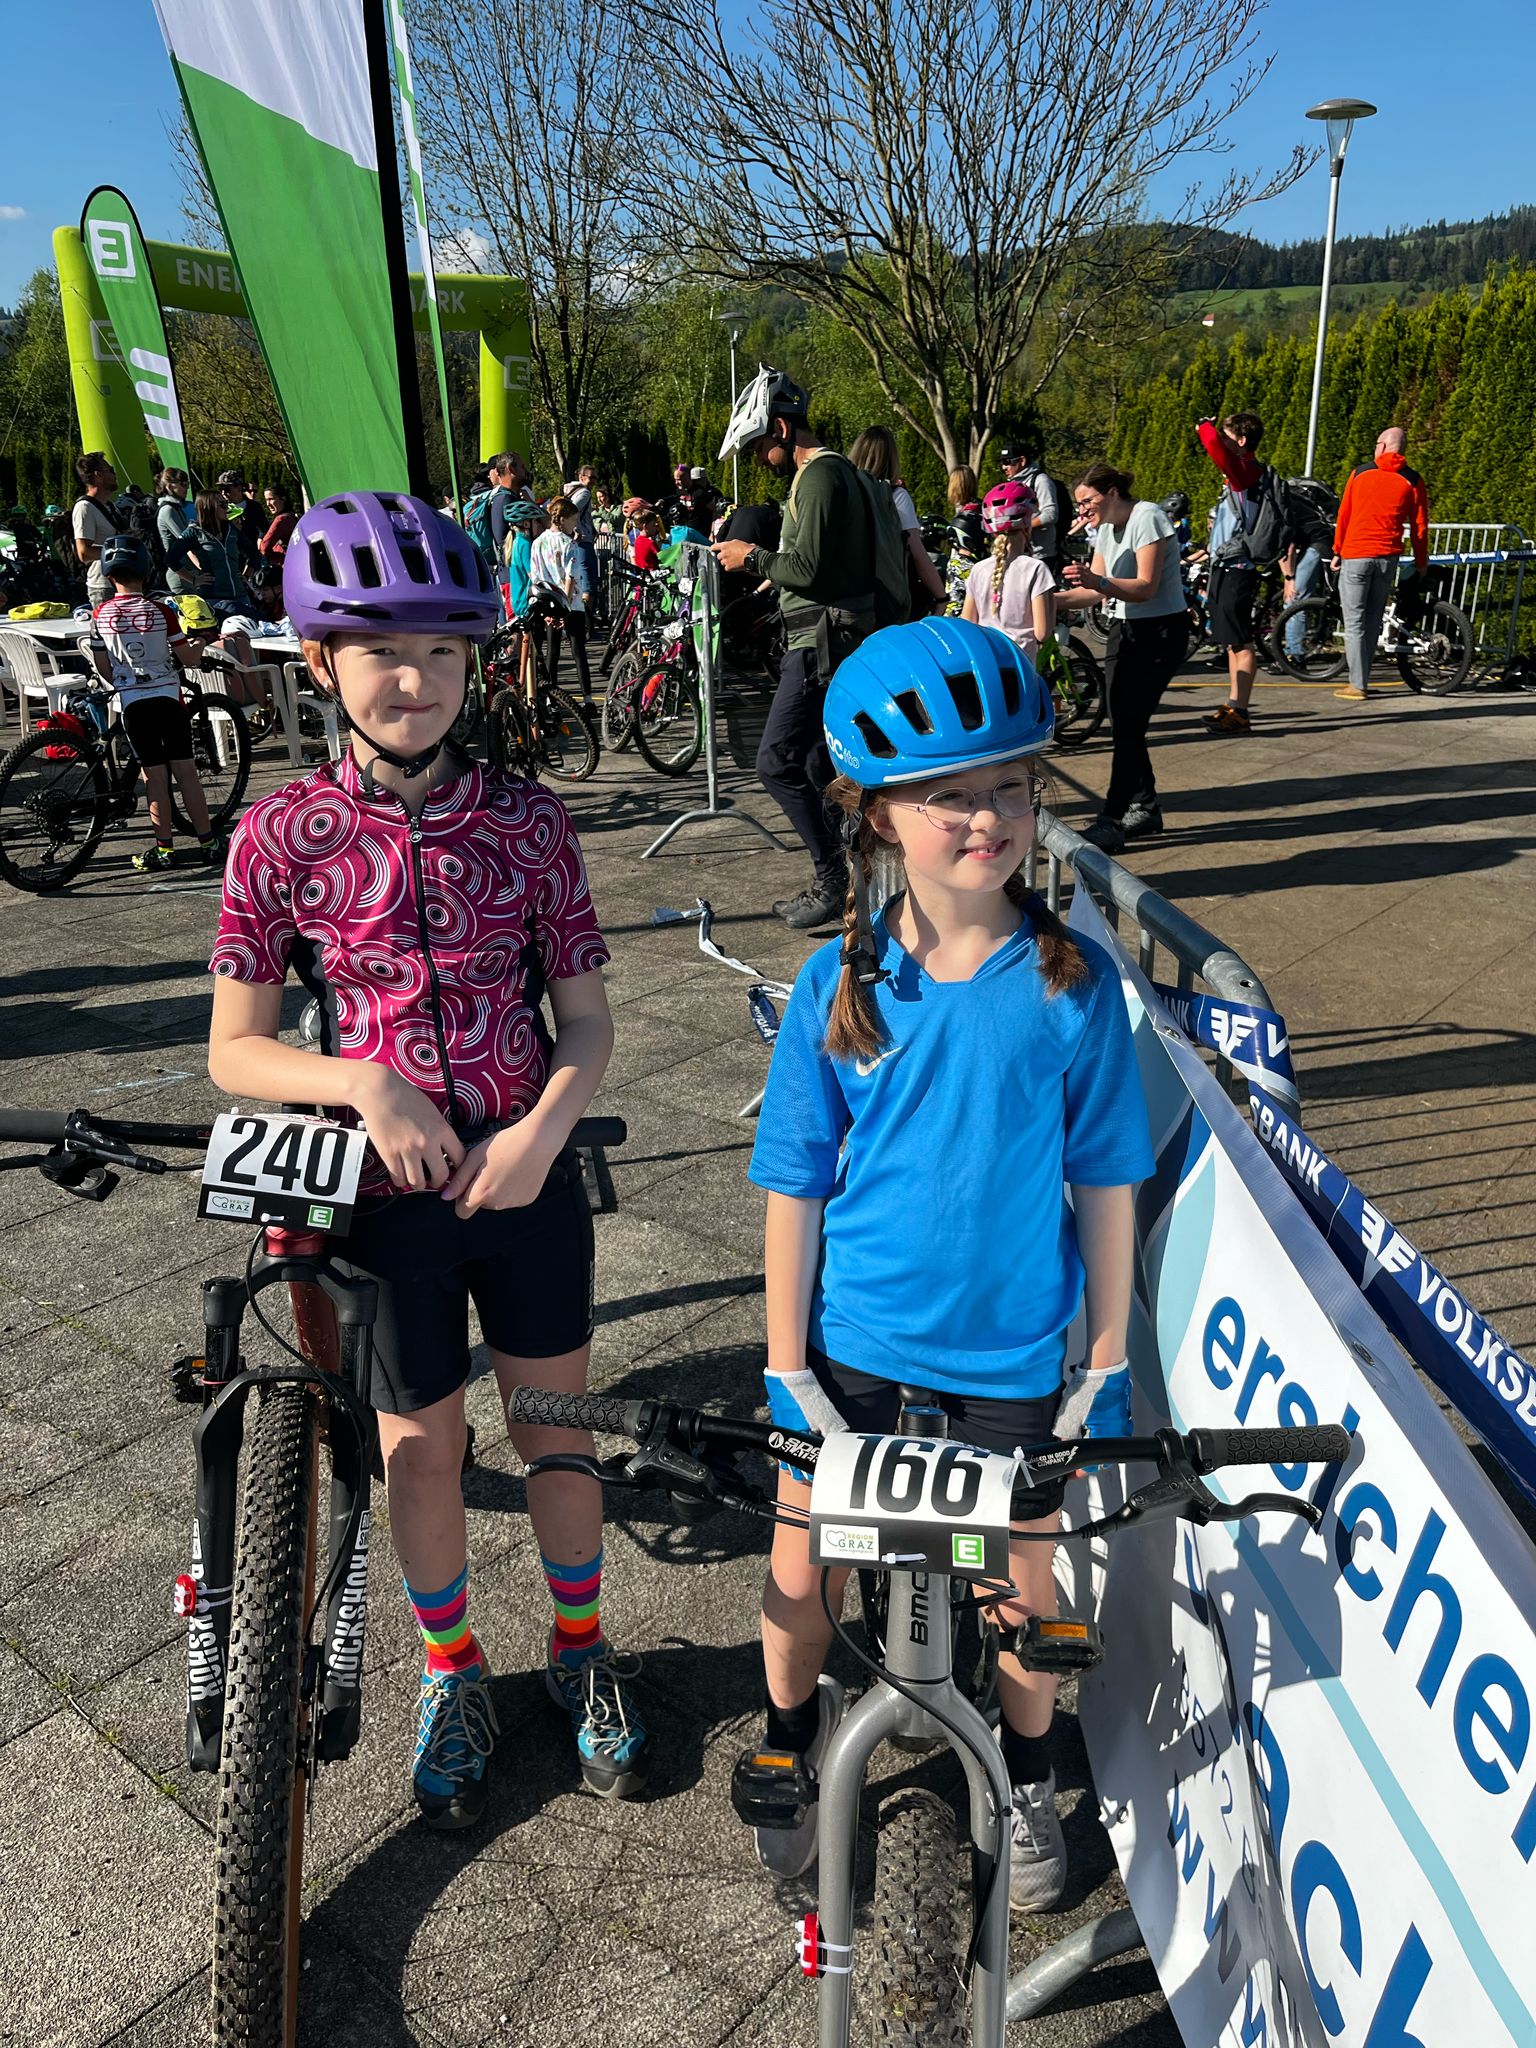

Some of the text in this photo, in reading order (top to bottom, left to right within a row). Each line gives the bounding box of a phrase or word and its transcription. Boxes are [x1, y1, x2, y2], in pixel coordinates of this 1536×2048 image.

[1157, 993, 1190, 1033] ANK
[220, 1117, 350, 1197] 240
[221, 1202, 250, 1212] GRAZ
[850, 1434, 992, 1517] 166
[838, 1538, 875, 1550] GRAZ
[326, 1553, 370, 1688] ROCKSHOX
